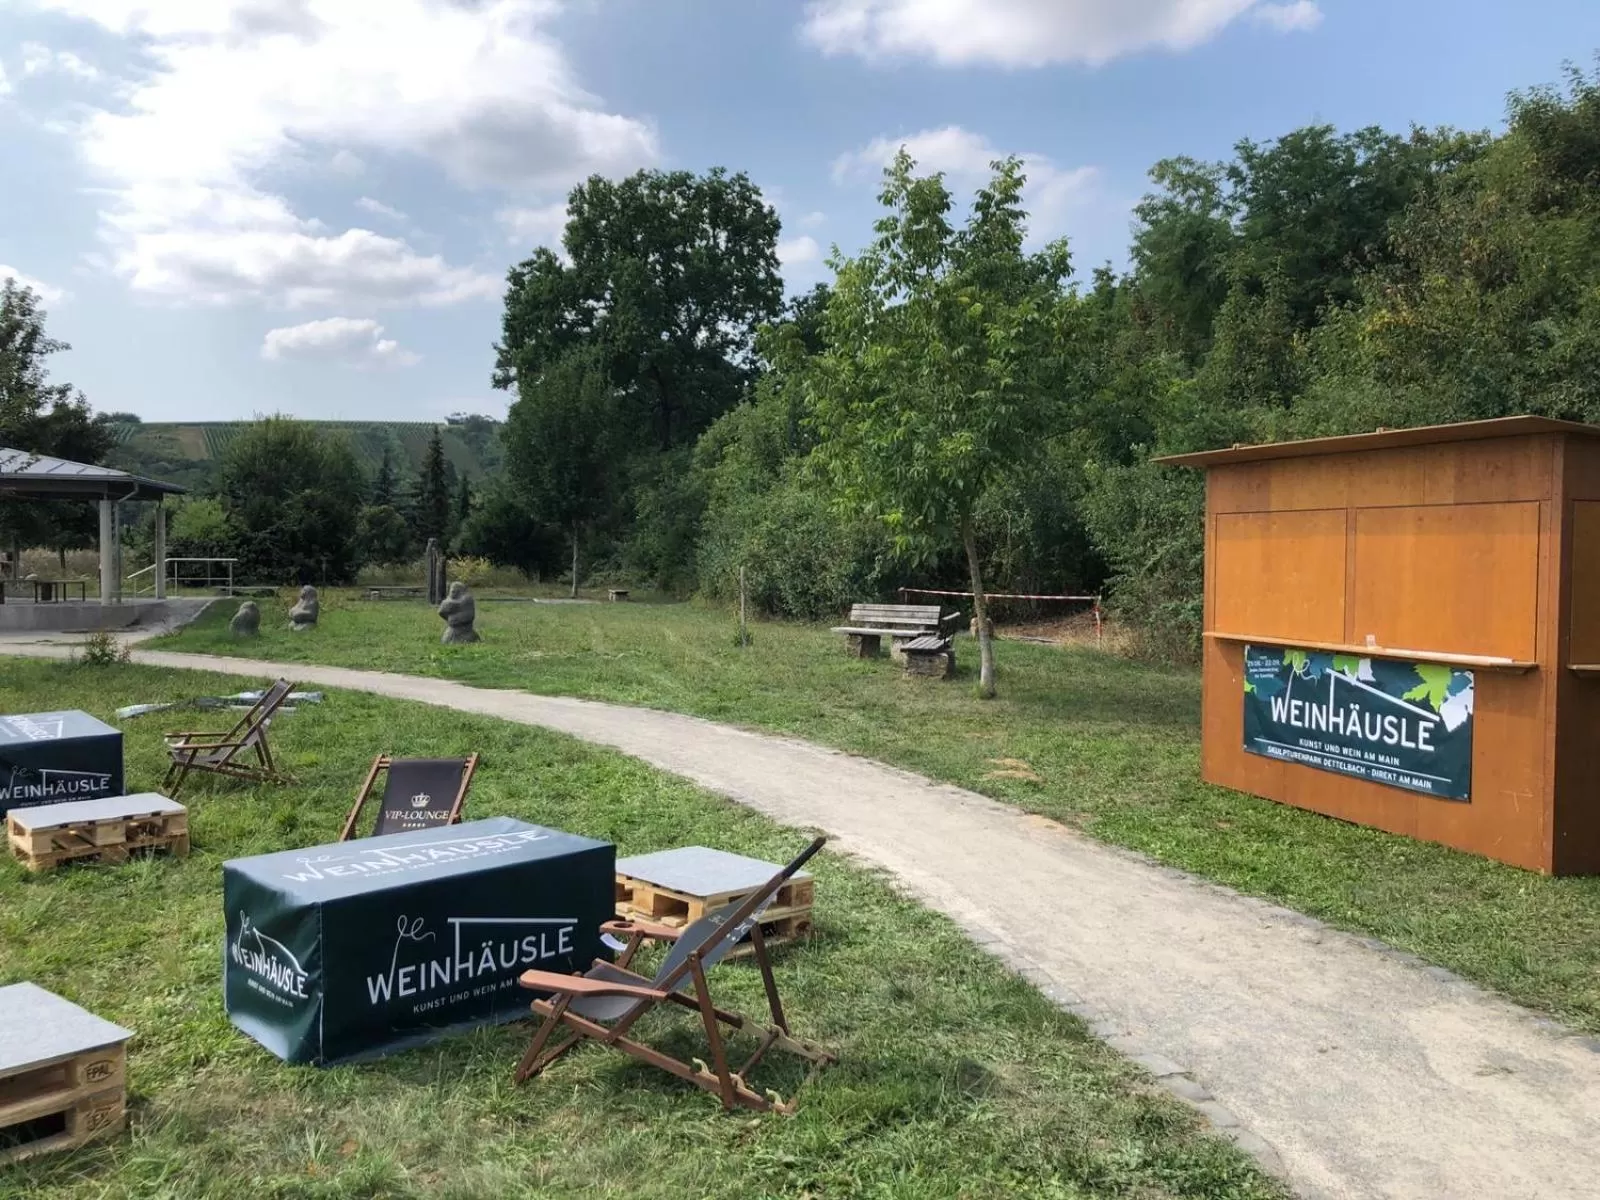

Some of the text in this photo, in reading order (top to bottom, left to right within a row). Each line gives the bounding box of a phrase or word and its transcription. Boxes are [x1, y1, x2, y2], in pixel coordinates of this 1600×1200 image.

[1270, 695, 1435, 751] WEINHÄUSLE
[1267, 745, 1322, 764] SKULPTURENPARK
[1323, 758, 1366, 775] DETTELBACH
[1371, 768, 1397, 781] DIREKT
[1398, 774, 1410, 785] AM
[1412, 777, 1432, 789] MAIN
[1299, 738, 1400, 766] KUNST UND WEIN AM MAIN
[0, 777, 110, 800] WEINHÄUSLE
[385, 810, 450, 820] VIP-LOUNGE
[280, 830, 549, 882] WEINHÄUSLE
[232, 943, 308, 999] WEINHÄUSLE
[366, 926, 574, 1005] WEINHÄUSLE
[413, 997, 446, 1014] KUNST
[449, 991, 470, 1004] UND
[473, 984, 496, 997] WEIN
[500, 978, 513, 989] AM
